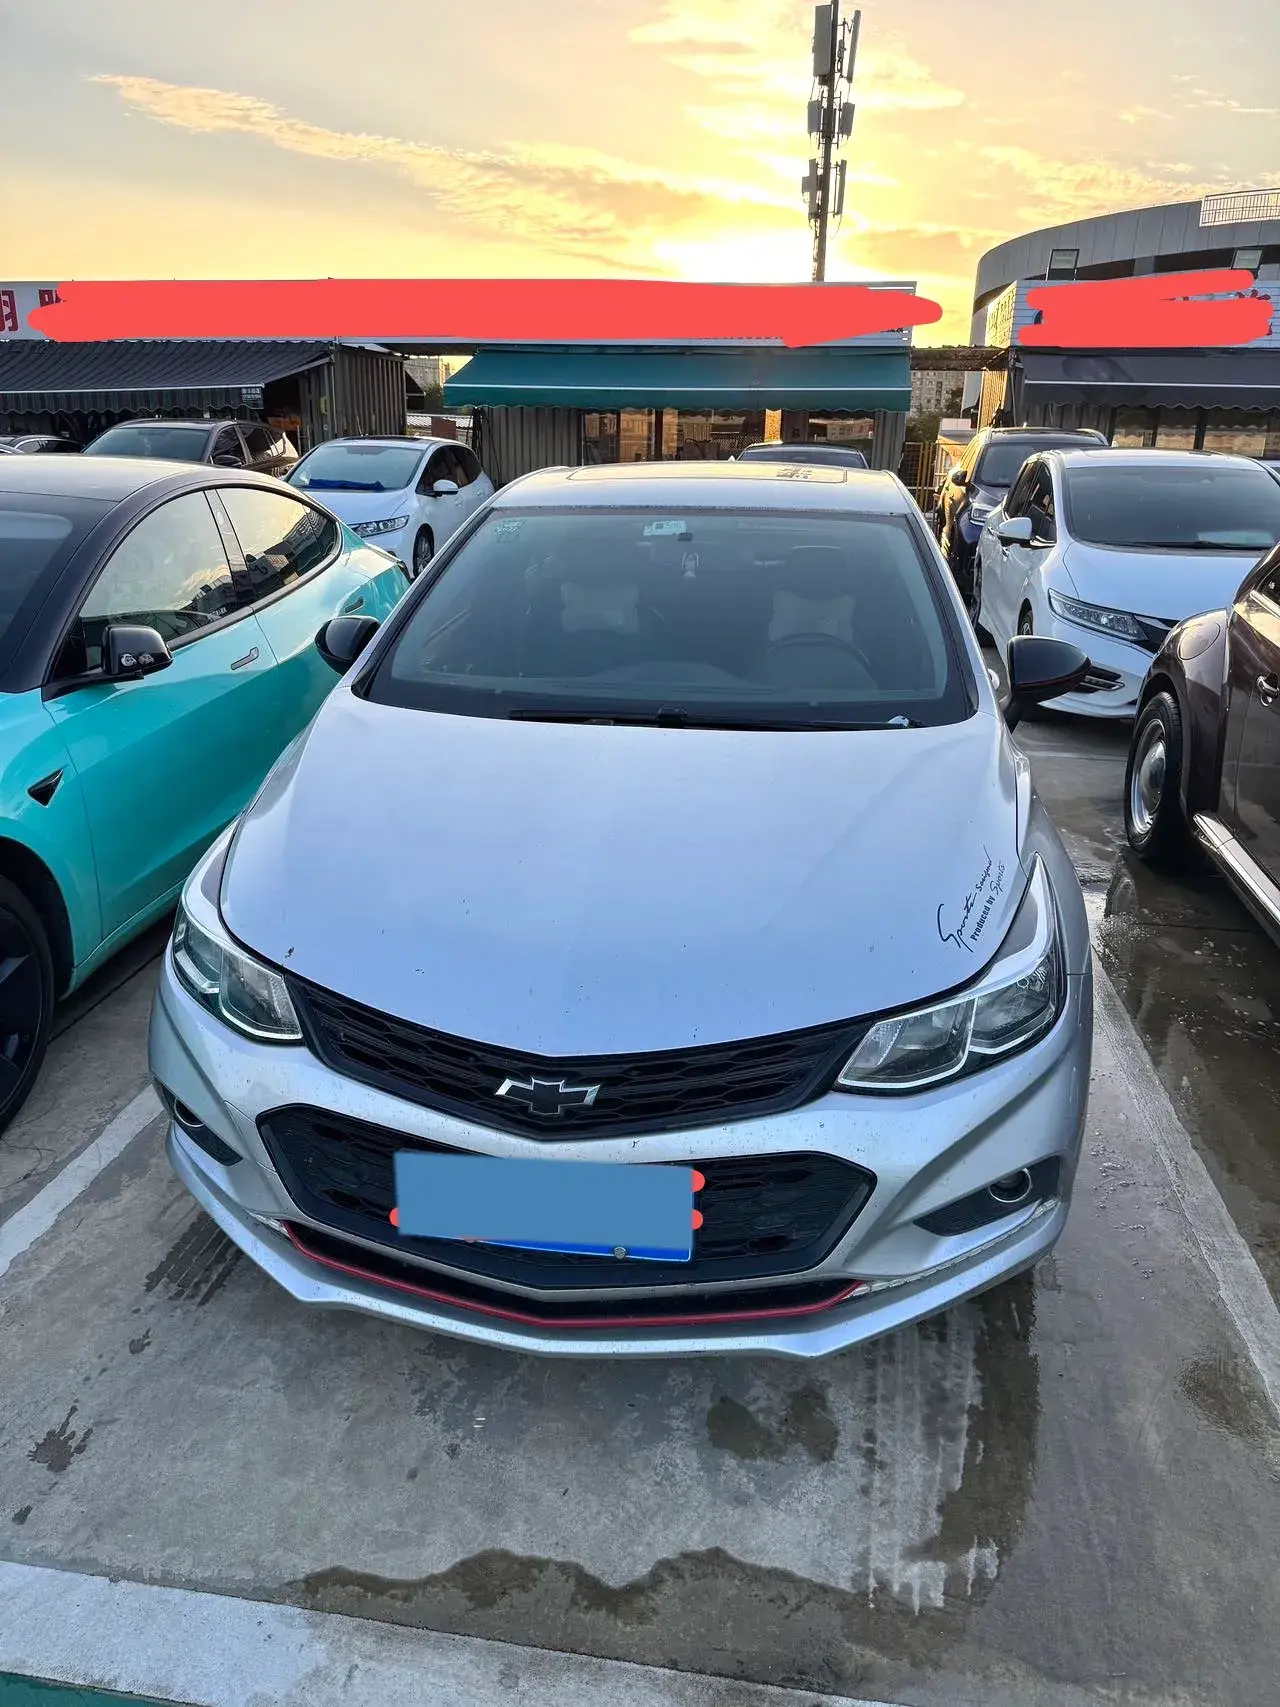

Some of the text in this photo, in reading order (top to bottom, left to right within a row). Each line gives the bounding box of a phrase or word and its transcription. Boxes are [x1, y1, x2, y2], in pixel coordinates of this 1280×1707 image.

[970, 860, 1006, 941] Produced by Sports
